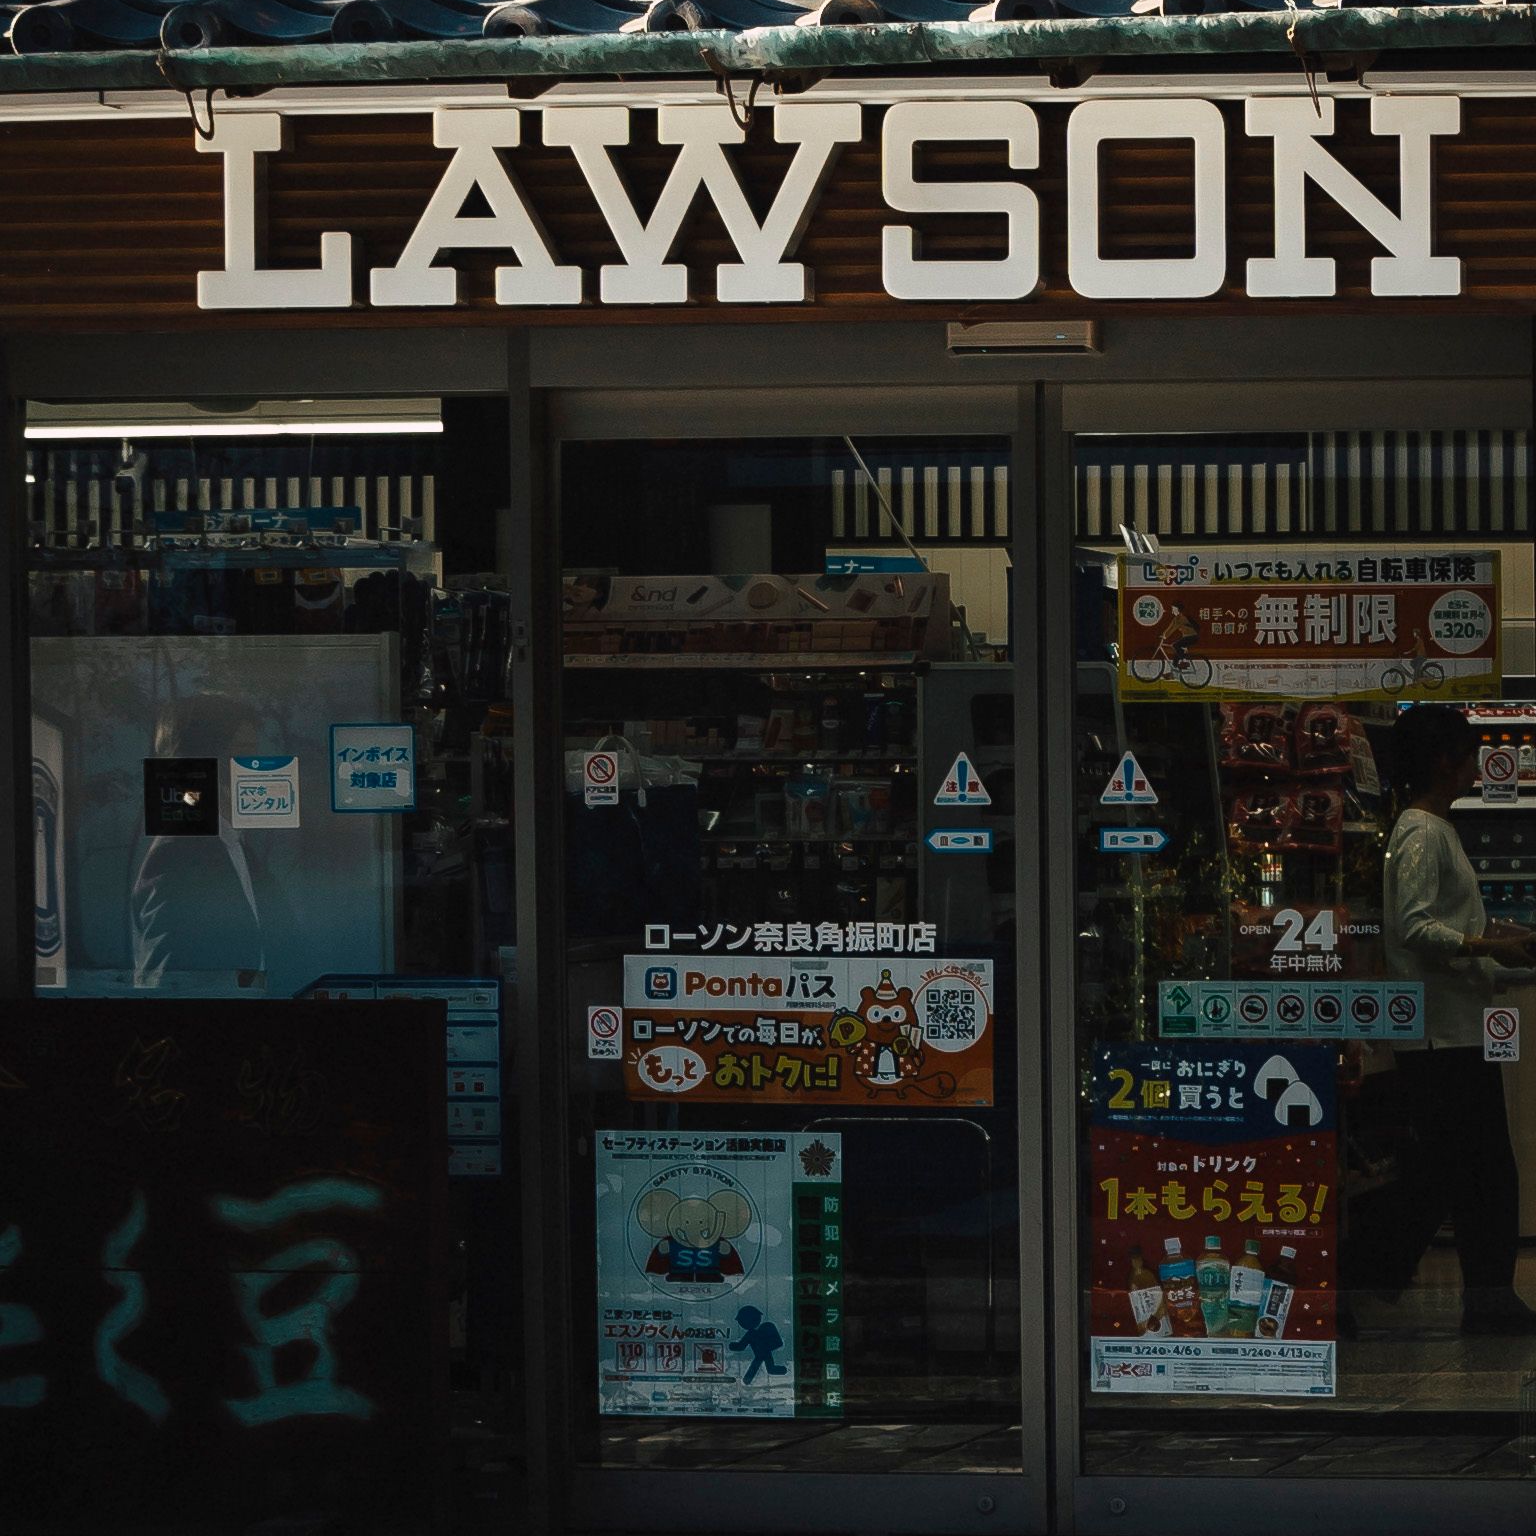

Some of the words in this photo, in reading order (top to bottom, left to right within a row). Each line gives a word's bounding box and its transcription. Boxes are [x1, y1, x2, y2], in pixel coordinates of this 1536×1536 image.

[194, 98, 1465, 310] LAWSON
[1253, 594, 1398, 646] 無制限
[338, 746, 410, 763] インボイス
[160, 786, 202, 805] Ubr
[240, 797, 288, 811] レンタル
[644, 921, 938, 953] ローソン奈良角振町店
[1239, 924, 1272, 935] OPEN
[1273, 908, 1339, 952] 24
[1339, 923, 1381, 935] HOURS
[1269, 954, 1343, 974] 年中無休
[643, 1053, 699, 1087] もっと
[714, 1053, 838, 1089] おトクに!
[619, 1345, 644, 1359] 110
[657, 1345, 683, 1359] 119
